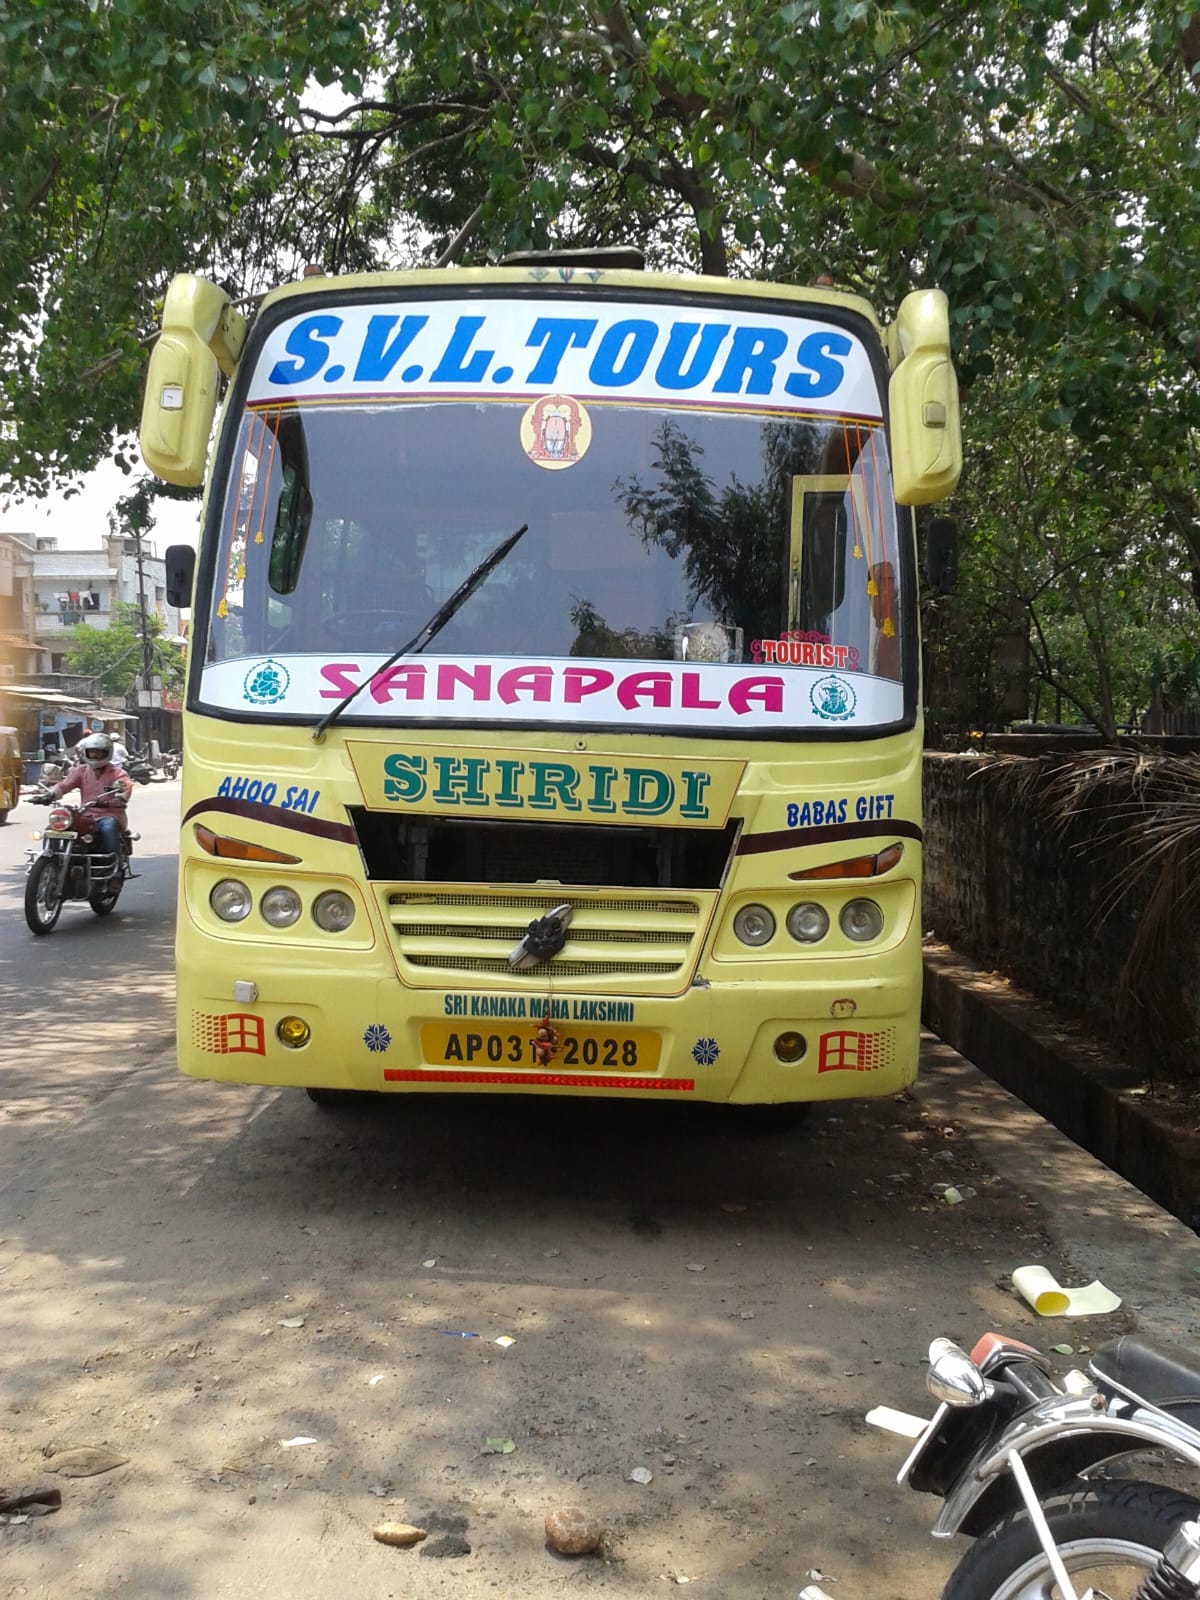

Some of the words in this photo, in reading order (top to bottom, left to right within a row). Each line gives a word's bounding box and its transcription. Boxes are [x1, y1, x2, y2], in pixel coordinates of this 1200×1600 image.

[762, 639, 850, 669] TOURIST
[319, 663, 785, 716] SANAPALA
[217, 776, 277, 806] AHOO
[281, 786, 321, 814] SAI
[383, 754, 711, 819] SHIRIDI
[786, 798, 848, 828] BABAS
[856, 794, 895, 821] GIFT
[444, 994, 468, 1015] SRI
[471, 996, 526, 1017] KANAKA
[529, 998, 570, 1019] MAHA
[573, 1000, 634, 1022] LAKSHMI
